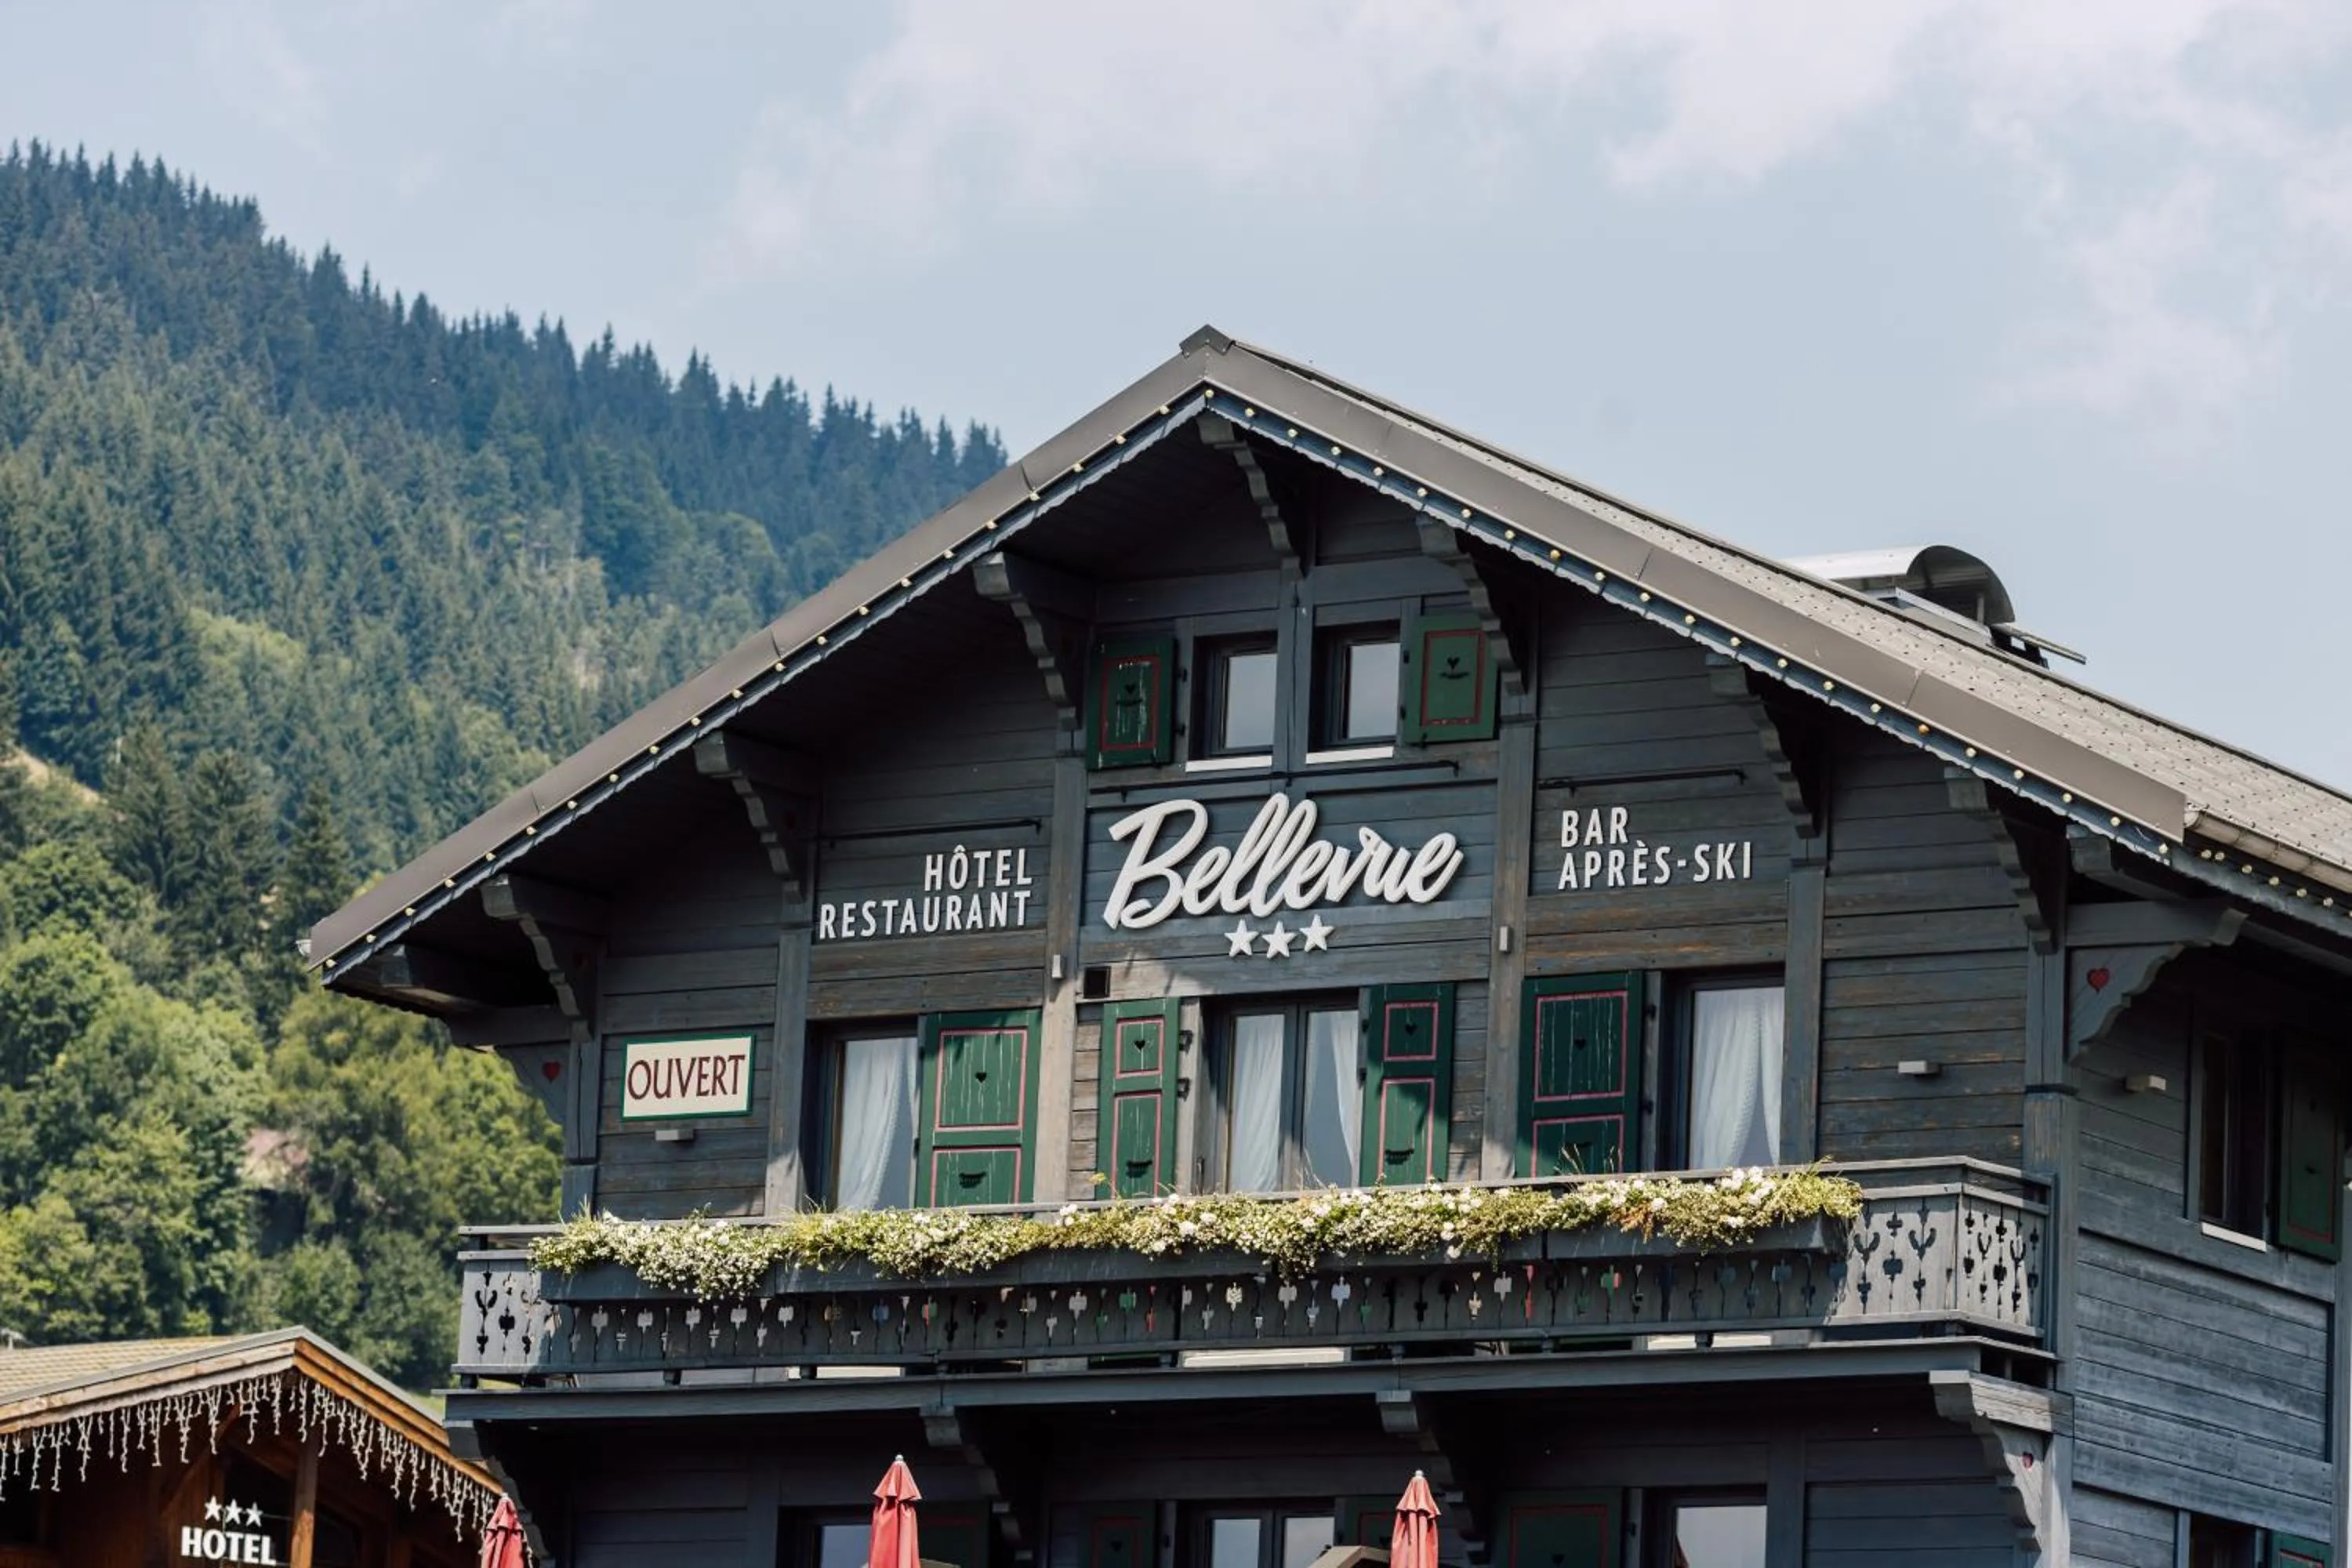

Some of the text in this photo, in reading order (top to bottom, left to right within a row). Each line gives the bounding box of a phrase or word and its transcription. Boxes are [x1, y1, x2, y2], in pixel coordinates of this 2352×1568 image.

[1561, 806, 1629, 848] BAR
[924, 844, 1033, 891] HÔTEL
[1103, 792, 1463, 930] Bellevue
[1558, 840, 1751, 890] APRÈS-SKI
[819, 891, 1032, 939] RESTAURANT
[627, 1054, 746, 1100] OUVERT
[181, 1526, 277, 1566] HOTEL
